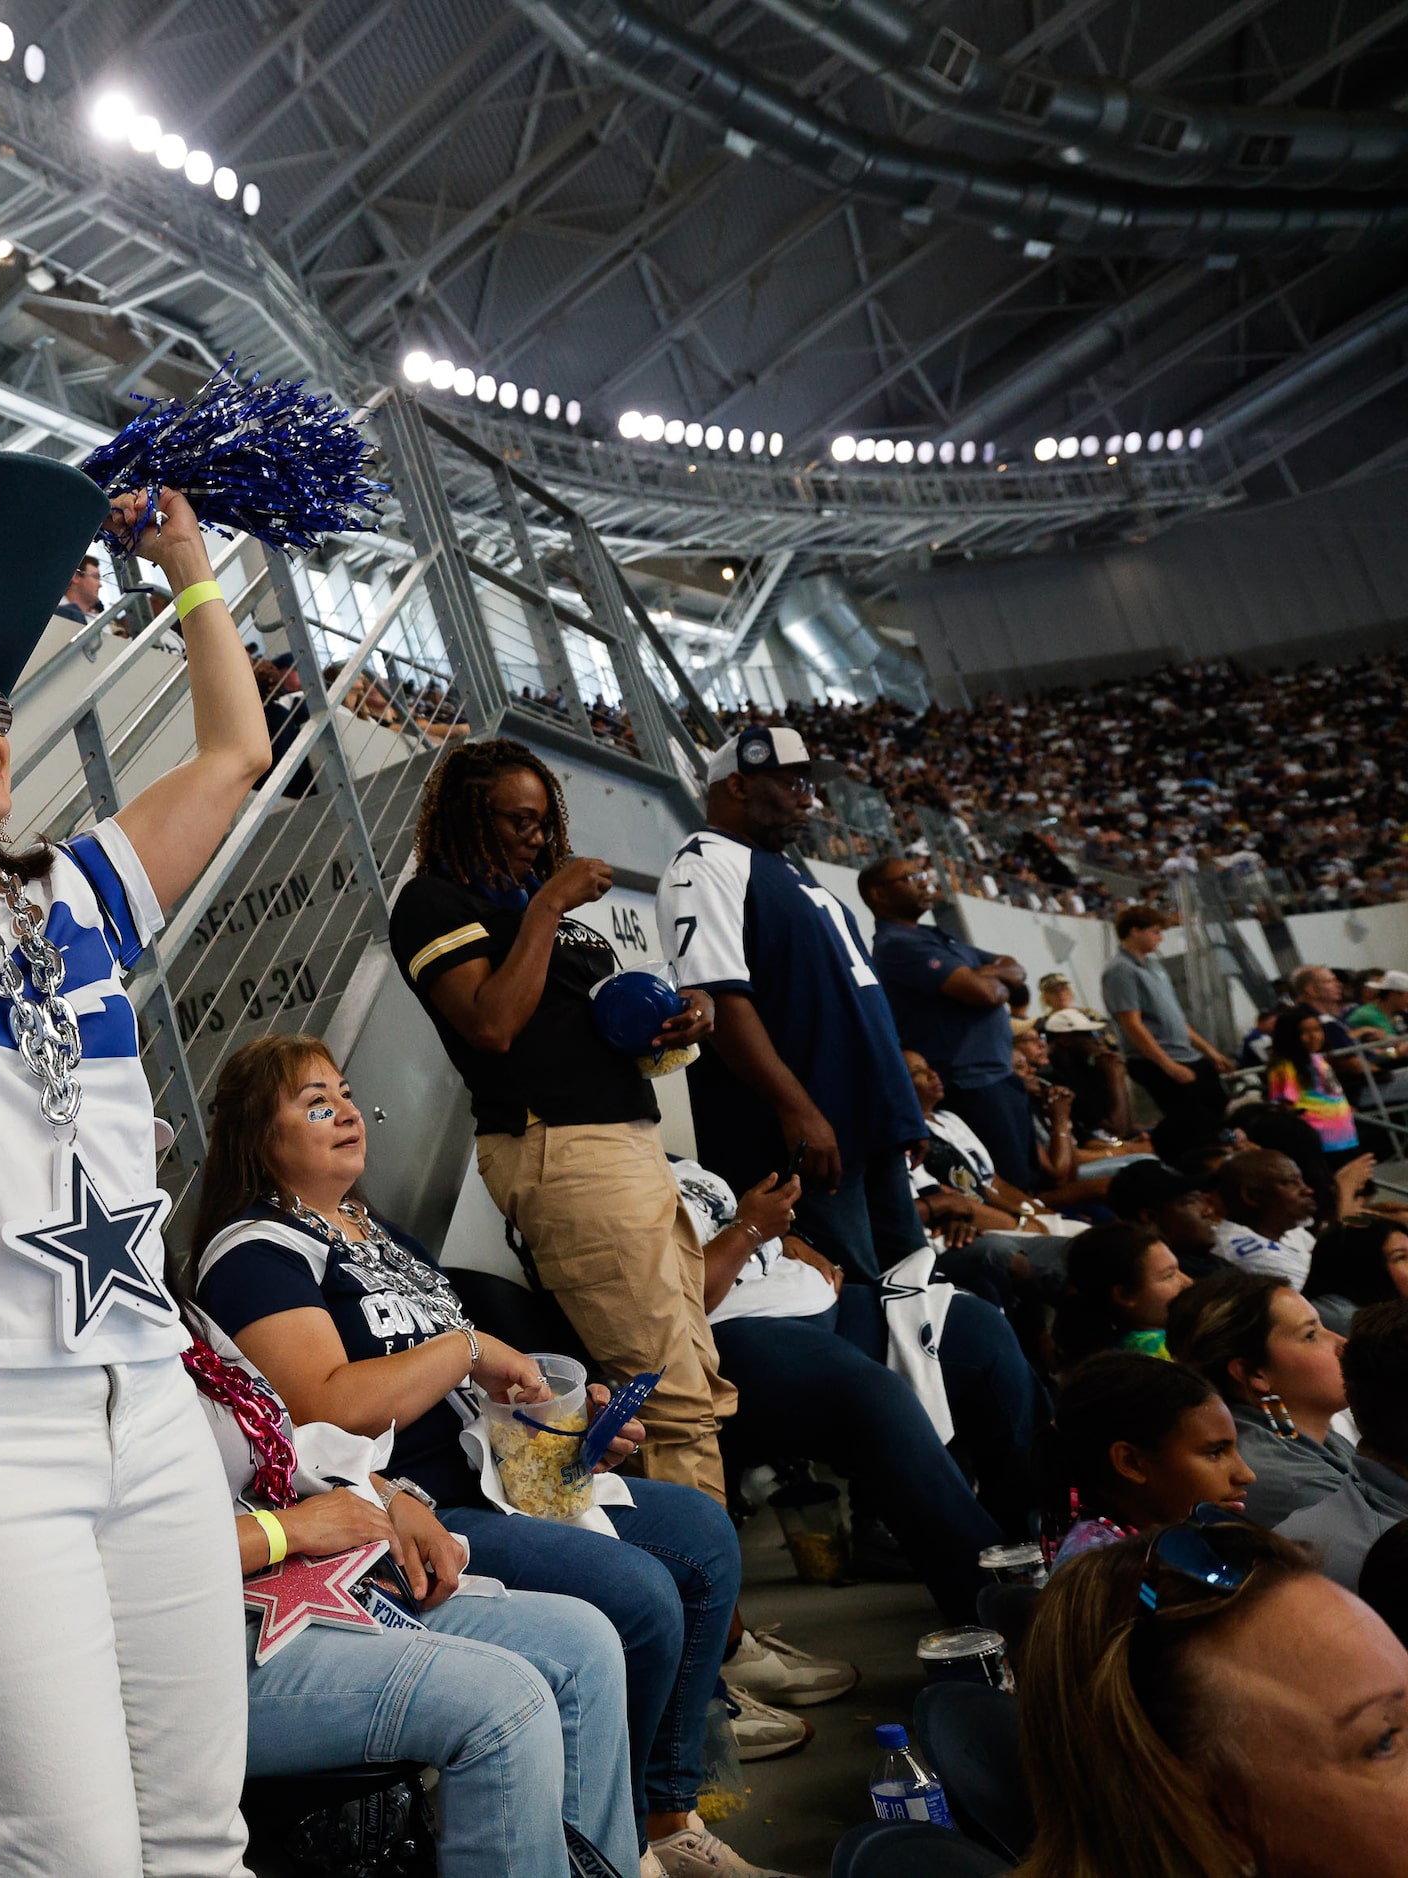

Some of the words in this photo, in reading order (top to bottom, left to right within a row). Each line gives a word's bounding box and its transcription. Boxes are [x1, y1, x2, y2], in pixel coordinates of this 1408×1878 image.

[194, 873, 315, 947] SECTION
[611, 905, 648, 953] 446
[674, 915, 698, 958] 7
